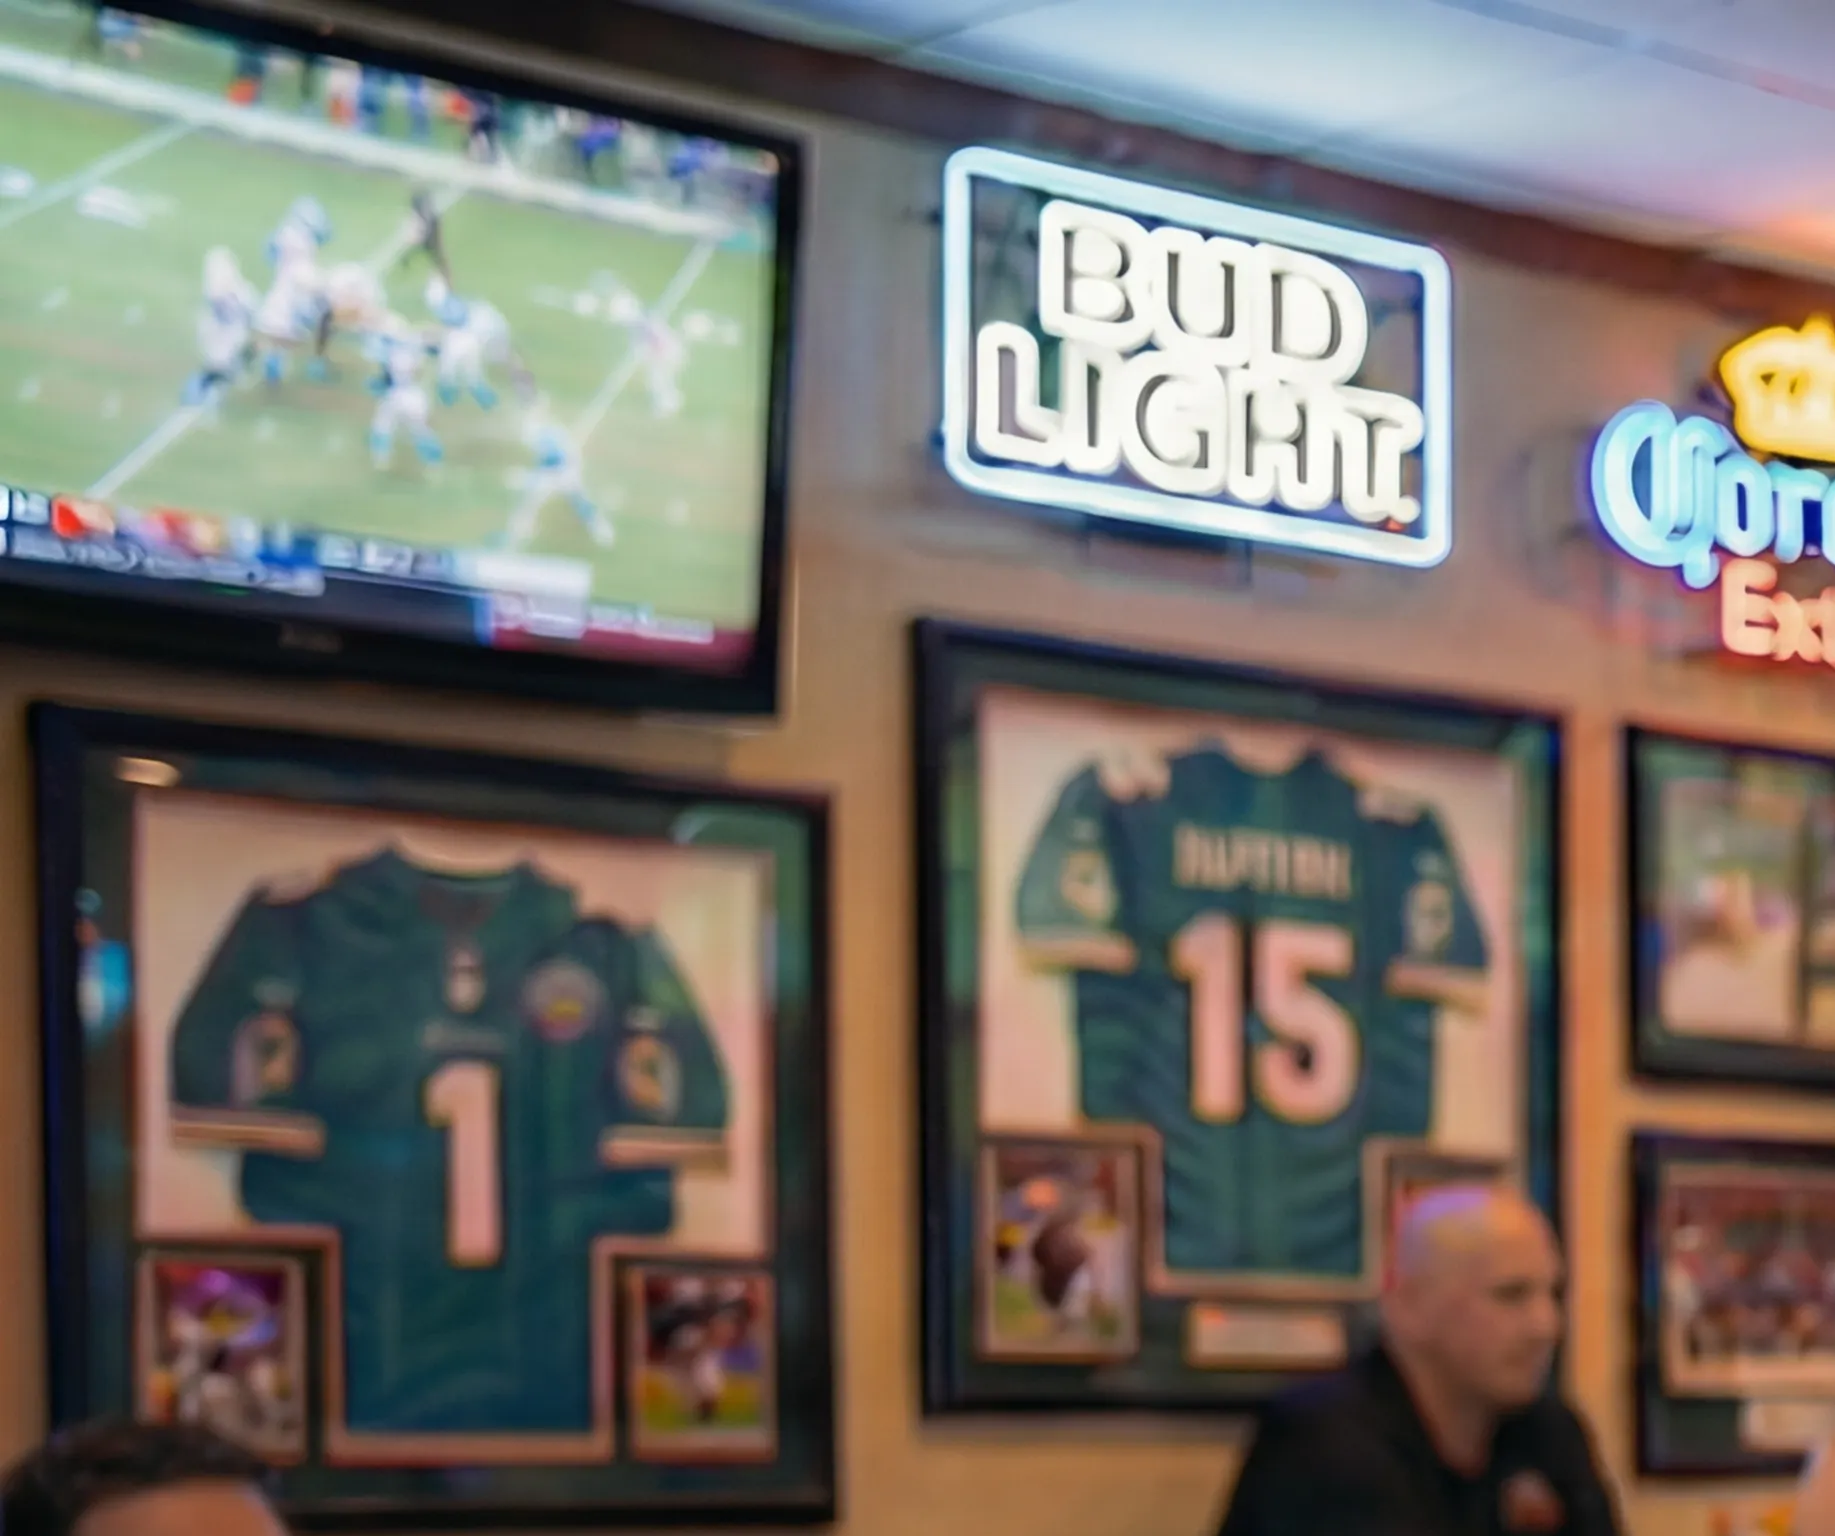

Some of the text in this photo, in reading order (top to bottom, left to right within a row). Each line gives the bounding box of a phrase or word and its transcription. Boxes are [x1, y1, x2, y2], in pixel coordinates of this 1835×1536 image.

[1039, 199, 1368, 389] BUD
[1172, 912, 1363, 1124] 15
[424, 1060, 501, 1267] 1
